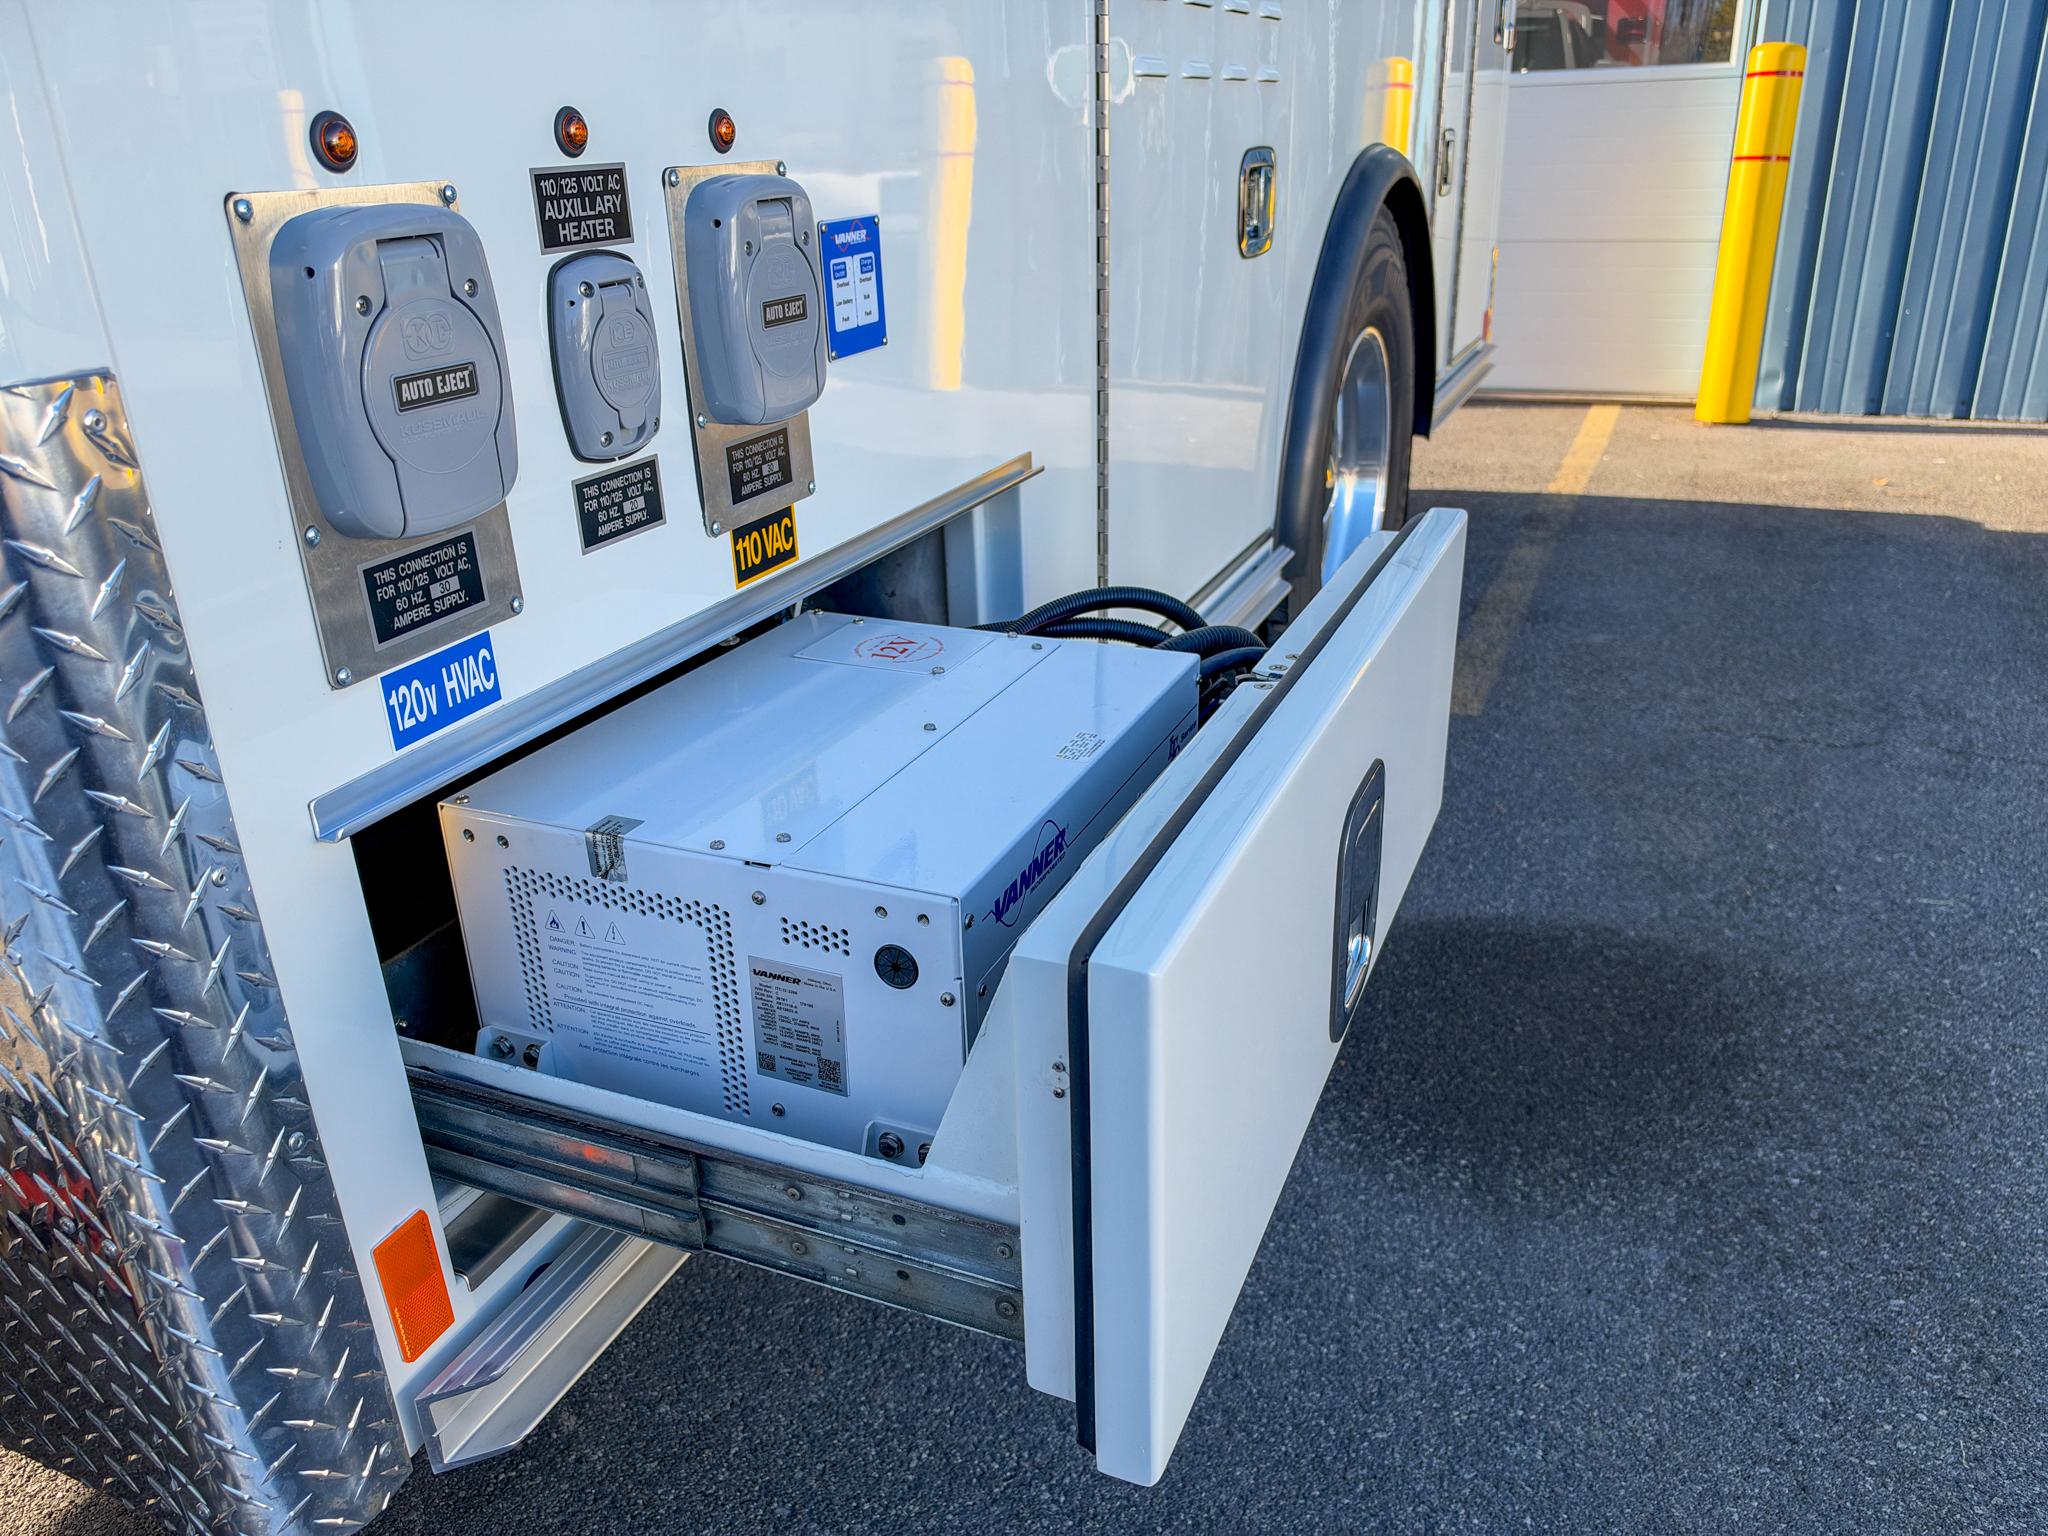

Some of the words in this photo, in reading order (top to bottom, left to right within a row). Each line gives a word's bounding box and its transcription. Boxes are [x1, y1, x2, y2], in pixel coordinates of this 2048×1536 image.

[540, 177, 578, 196] 110/125
[580, 175, 603, 193] VOLT
[608, 174, 620, 190] AC
[545, 194, 621, 220] AUXILLARY
[559, 218, 616, 242] HEATER
[835, 230, 867, 244] VANNER
[766, 306, 783, 321] AUTO
[785, 300, 804, 317] EJECT
[401, 378, 433, 402] AUTO
[436, 370, 470, 394] EJECT
[732, 447, 745, 461] THIS
[745, 437, 778, 456] CONNECTION
[778, 435, 784, 445] IS
[732, 462, 743, 474] FOR
[744, 455, 762, 469] 110/125
[765, 449, 776, 461] VOLT
[583, 485, 599, 499] THIS
[601, 471, 643, 493] CONNECTION
[644, 467, 651, 478] IS
[584, 499, 598, 513] FOR
[600, 491, 623, 508] 110/125
[627, 484, 641, 498] VOLT
[643, 481, 654, 492] AC,
[741, 479, 763, 496] AMPERE
[764, 472, 784, 486] SUPPLY.
[598, 510, 607, 522] 60
[609, 506, 620, 518] HZ.
[629, 500, 638, 511] 20
[598, 519, 624, 537] AMPERE
[625, 509, 650, 527] SUPPLY.
[736, 531, 762, 571] 110
[762, 517, 793, 558] VAC
[374, 567, 396, 586] THIS
[399, 546, 456, 577] CONNECTION
[458, 541, 467, 556] IS
[376, 585, 396, 602] FOR
[397, 572, 430, 595] 110/125
[434, 562, 454, 580] VOLT
[457, 556, 471, 571] AC,
[394, 608, 432, 630] AMPERE
[434, 590, 469, 614] SUPPLY.
[396, 596, 408, 611] 60
[411, 590, 427, 605] HZ.
[439, 581, 450, 595] 30
[389, 679, 437, 732] 120v
[441, 647, 495, 708] HVAC
[994, 828, 1066, 924] VANNER
[752, 968, 801, 985] VANNER
